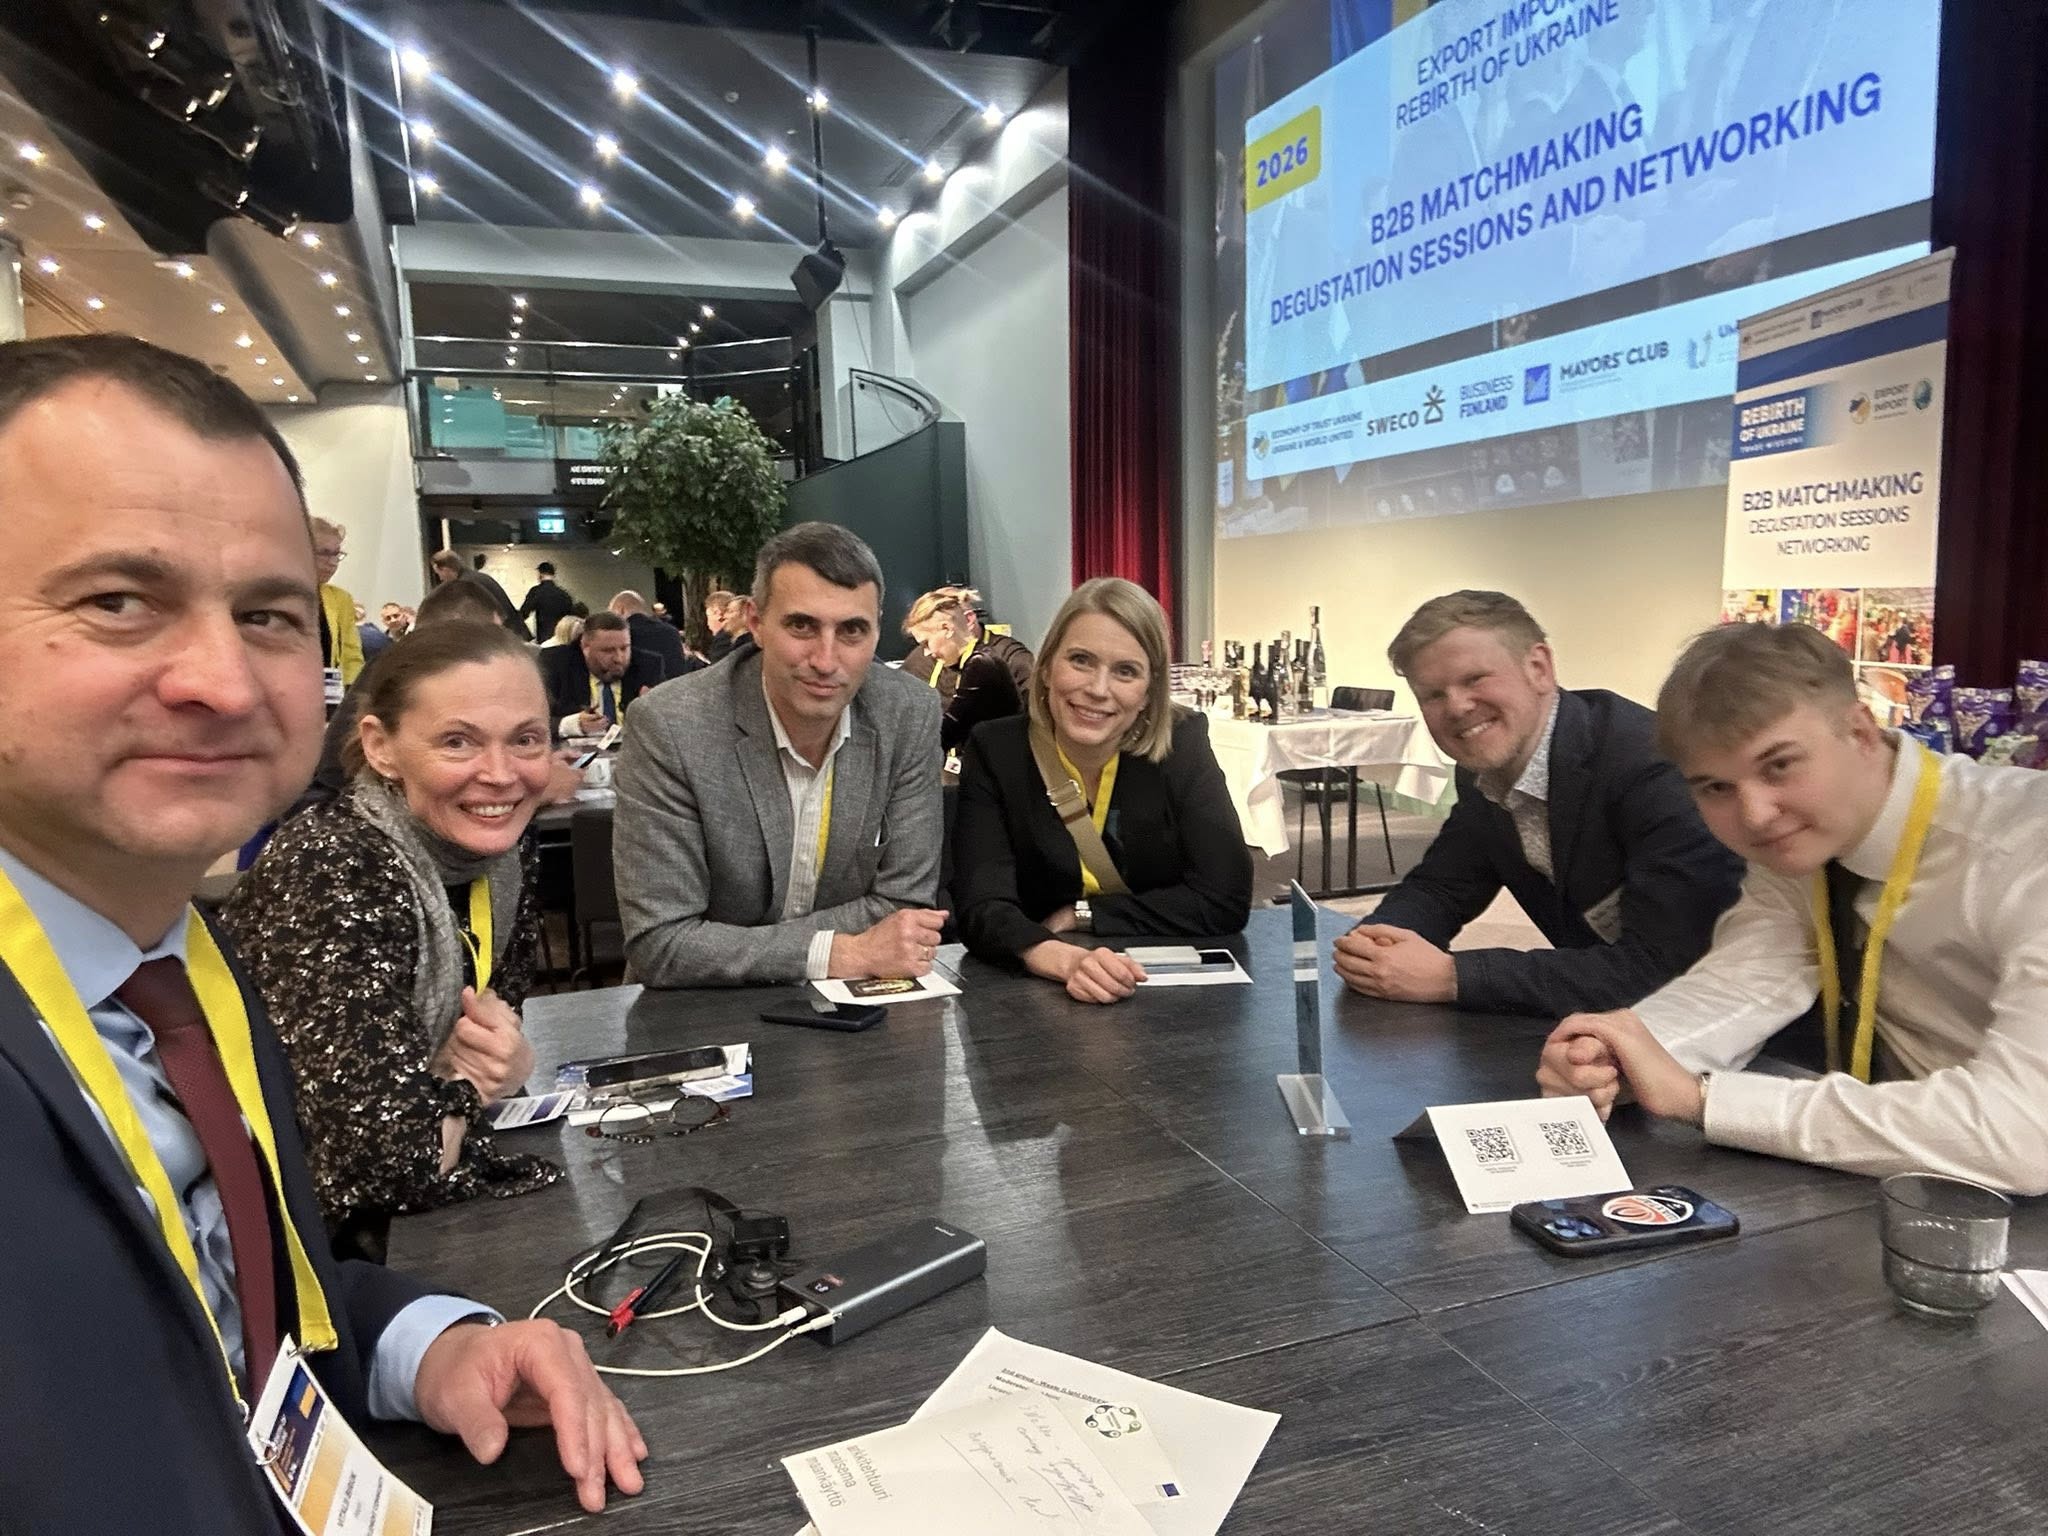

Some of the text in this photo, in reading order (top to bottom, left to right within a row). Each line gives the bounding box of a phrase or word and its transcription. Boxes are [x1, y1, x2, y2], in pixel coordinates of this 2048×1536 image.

[1396, 1, 1620, 129] REBIRTH OF UKRAINE
[1417, 19, 1496, 86] EXPORT
[1256, 136, 1308, 187] 2026
[1371, 103, 1643, 245] B2B MATCHMAKING
[1271, 72, 1881, 326] DEGUSTATION SESSIONS AND NETWORKING
[1626, 341, 1669, 365] CLUB
[1460, 375, 1513, 400] BUSINESS
[1367, 411, 1419, 436] SWECO
[1460, 395, 1508, 418] FINLAND
[1741, 397, 1806, 427] REBIRTH
[1739, 418, 1805, 441] OF UKRAINE
[1743, 471, 1923, 511] B2B MATCHMAKING
[1749, 506, 1911, 534] DEGUSTATION SESSIONS
[1777, 536, 1871, 555] NETWORKING
[805, 1456, 847, 1508] maankäyttö
[826, 1450, 857, 1488] maisema
